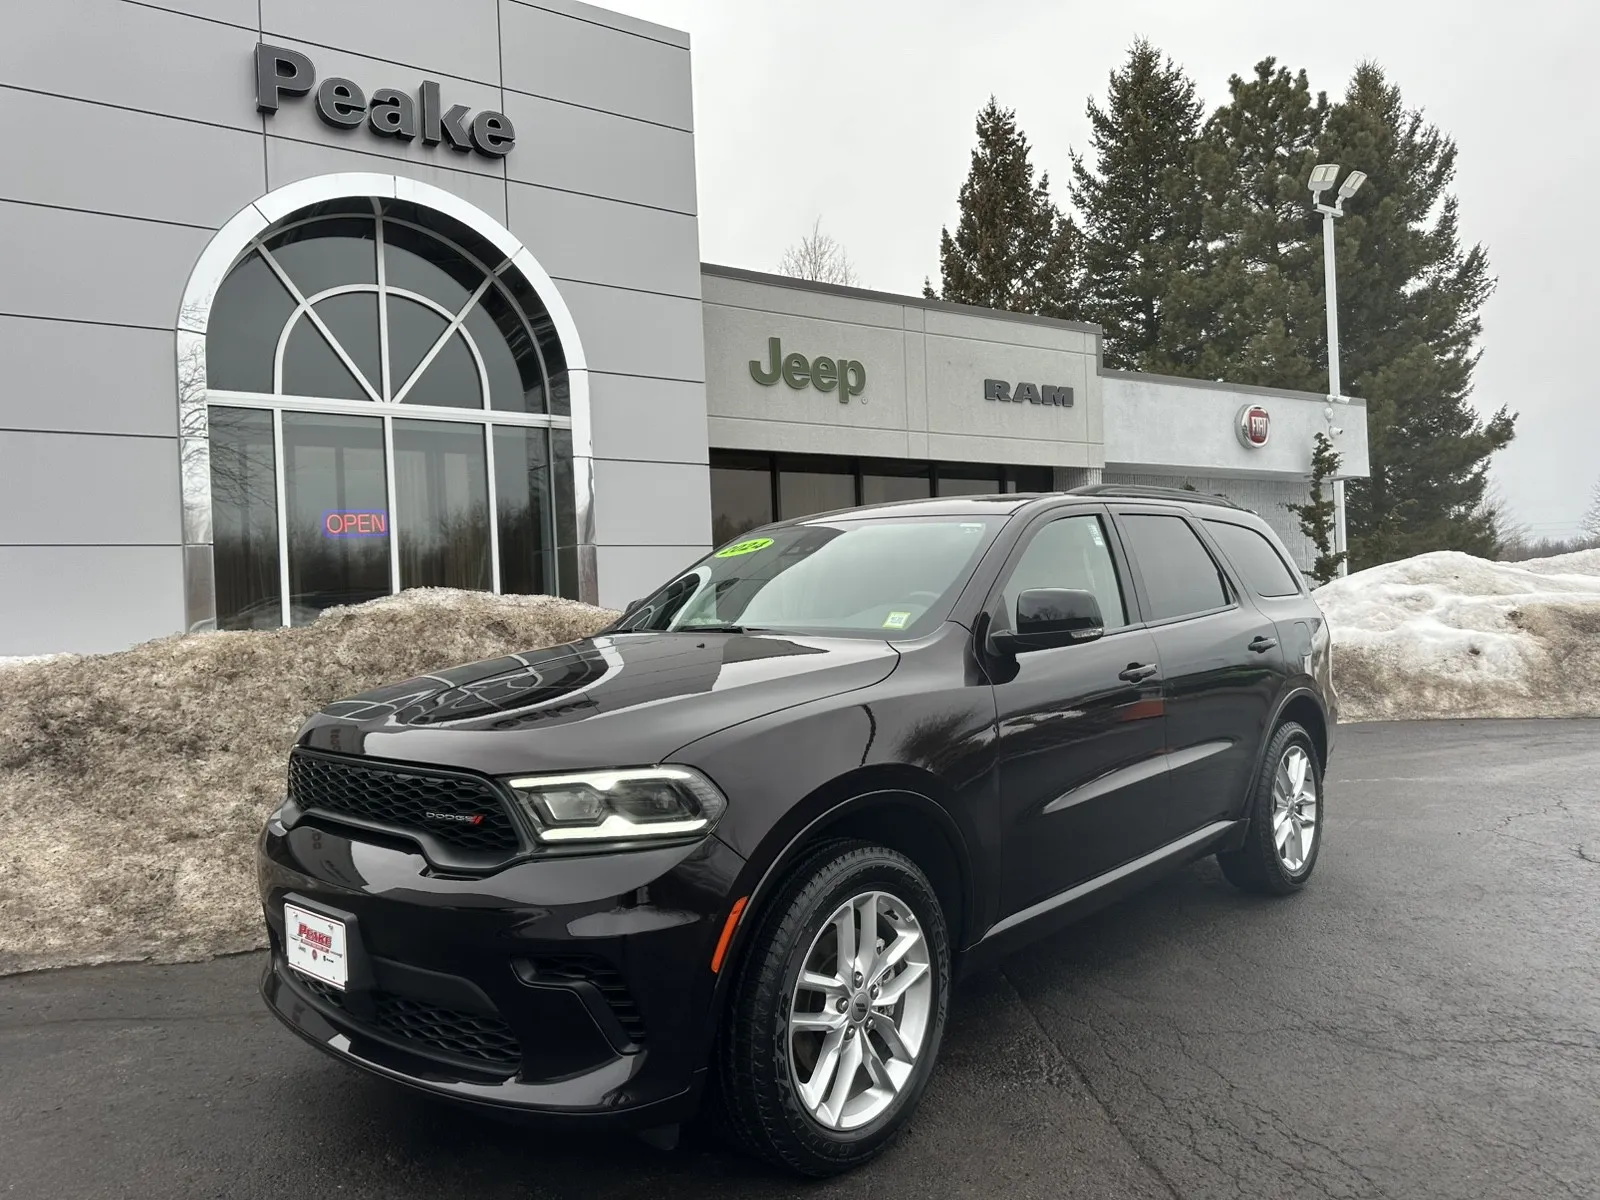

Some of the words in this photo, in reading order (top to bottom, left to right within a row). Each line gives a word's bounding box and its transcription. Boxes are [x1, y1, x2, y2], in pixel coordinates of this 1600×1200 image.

[255, 42, 515, 159] Peake
[748, 336, 866, 404] Jeep
[984, 378, 1074, 408] RAM
[1251, 416, 1268, 437] FIAT
[326, 513, 386, 534] OPEN
[718, 540, 771, 555] 2024
[425, 811, 475, 823] DODGE
